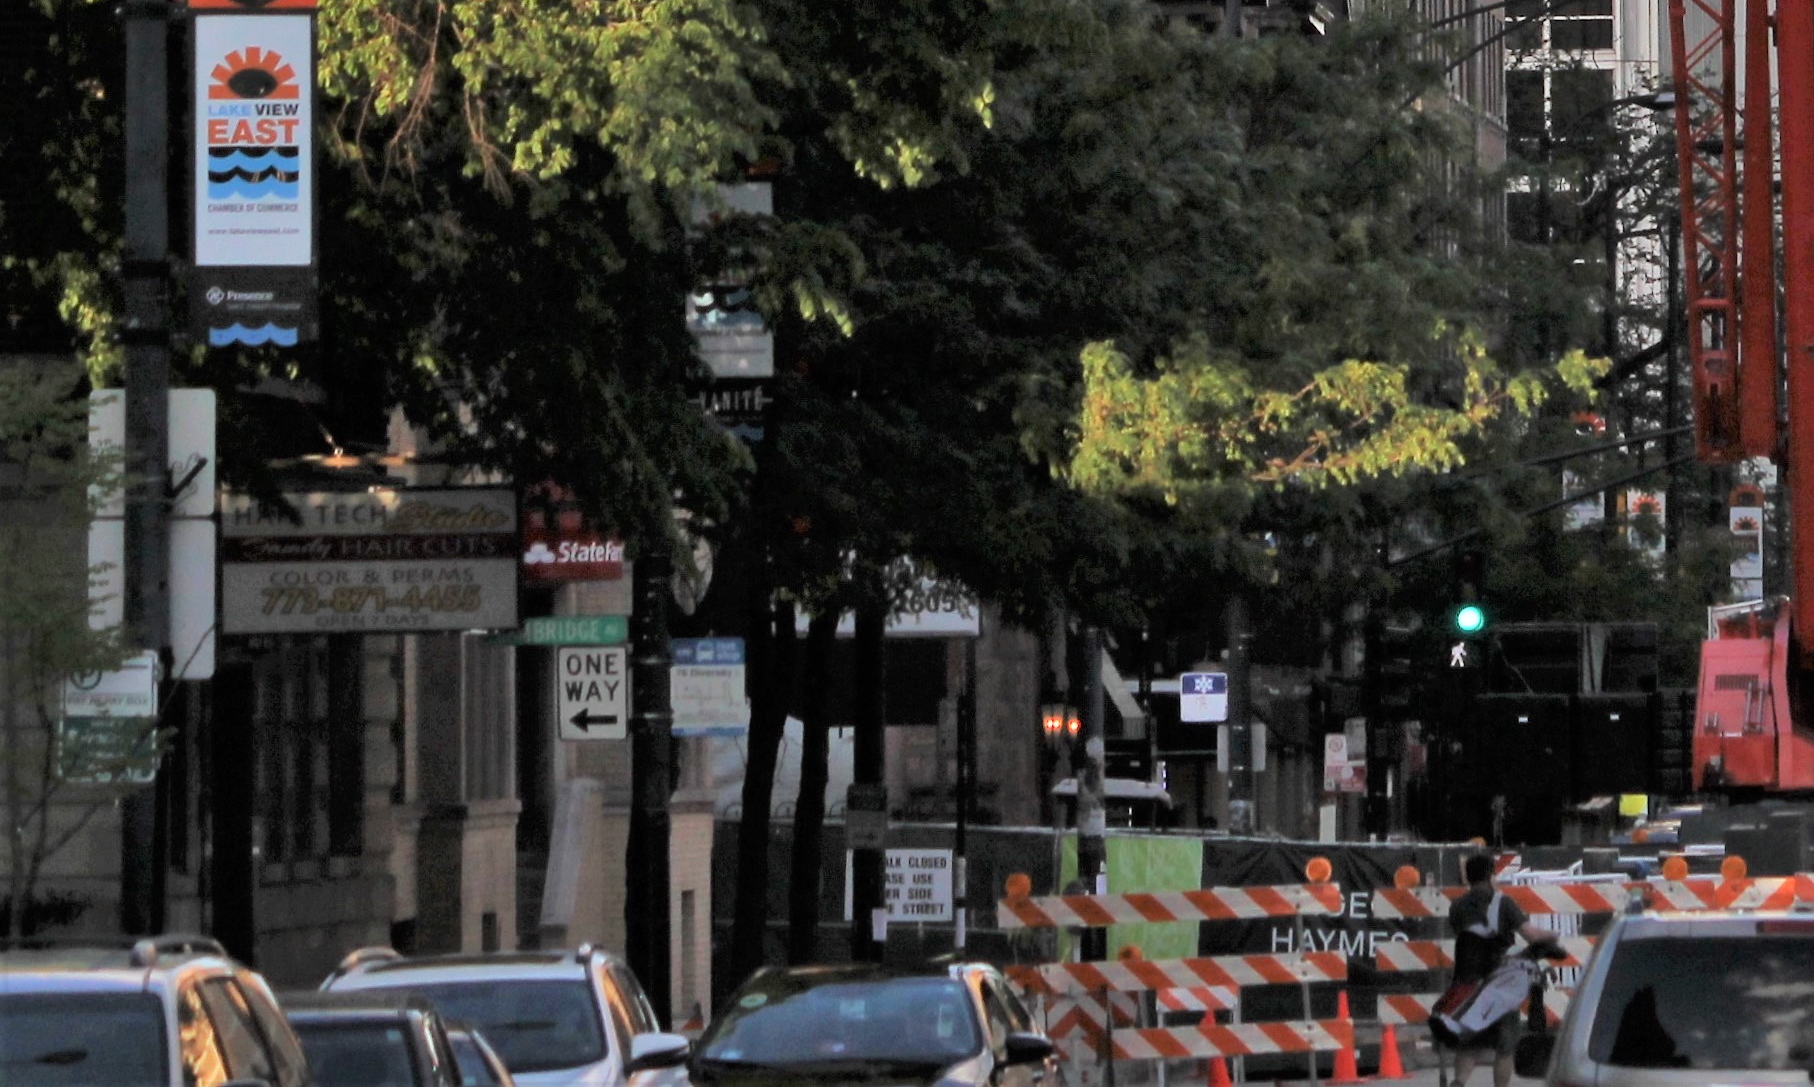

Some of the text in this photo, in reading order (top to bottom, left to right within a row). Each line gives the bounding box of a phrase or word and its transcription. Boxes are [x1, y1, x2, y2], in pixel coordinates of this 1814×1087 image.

[207, 103, 299, 116] LAKE VIEW
[207, 118, 300, 145] EAST
[315, 504, 388, 526] TECH
[341, 539, 412, 557] HAIR
[422, 537, 497, 556] CUTS
[269, 567, 476, 587] COLOR & PERMS
[260, 584, 483, 618] 773-871-4455
[526, 620, 599, 643] BRIDGE
[566, 653, 619, 676] ONE
[565, 679, 620, 703] WAY
[908, 856, 947, 870] CLOSED
[912, 873, 933, 885] USE
[907, 888, 933, 900] SIDE
[902, 903, 945, 915] STREET
[1271, 926, 1410, 958] HAYME
